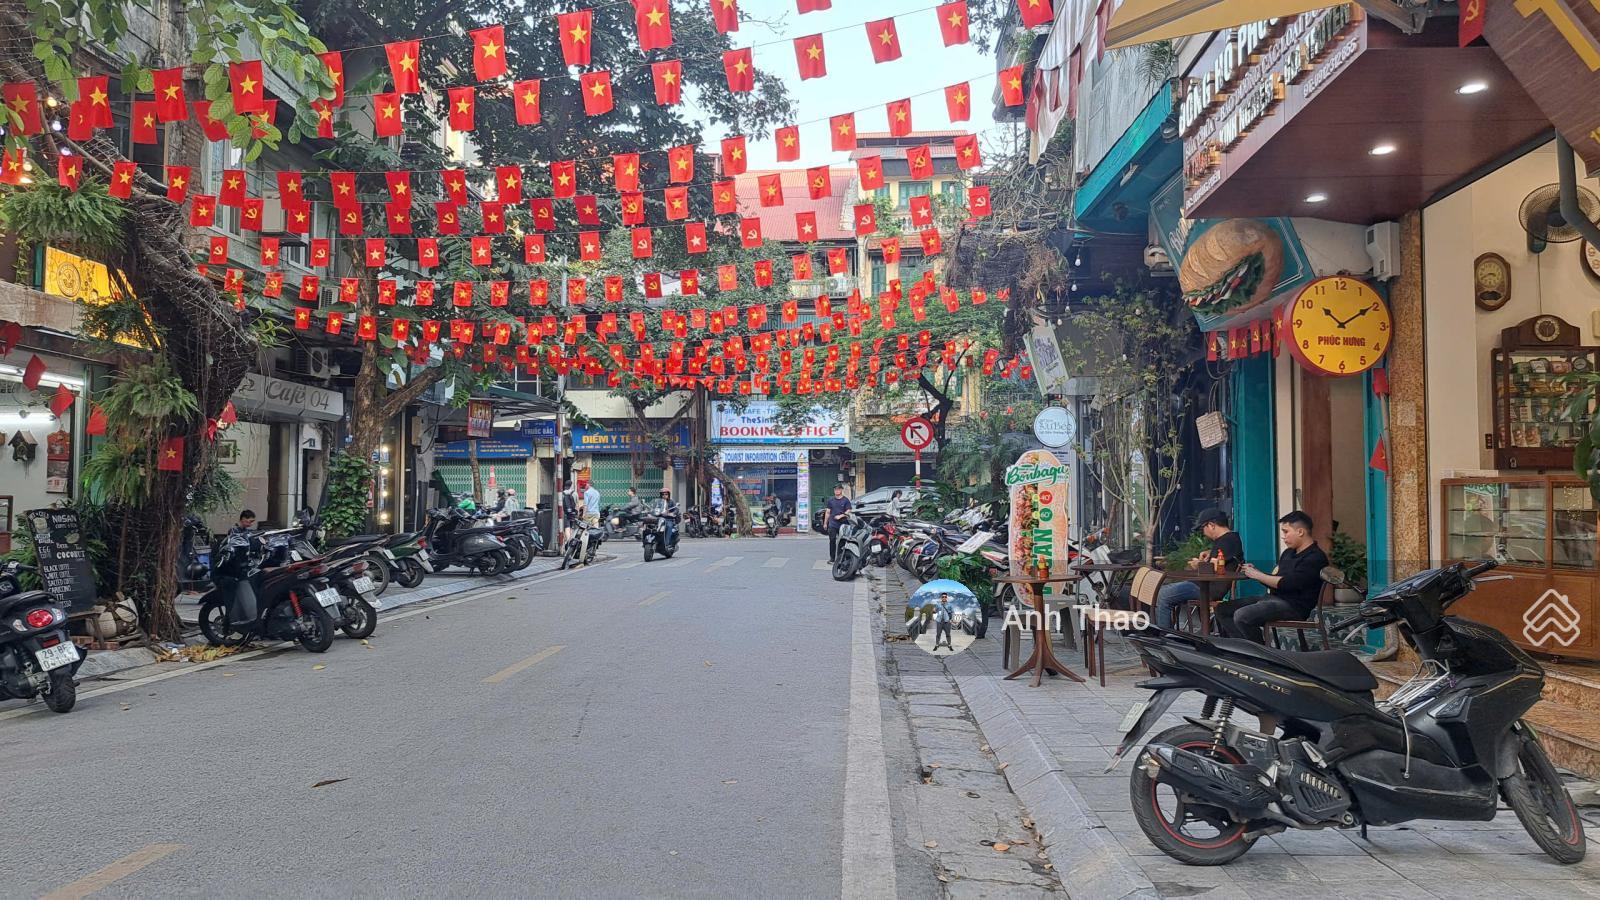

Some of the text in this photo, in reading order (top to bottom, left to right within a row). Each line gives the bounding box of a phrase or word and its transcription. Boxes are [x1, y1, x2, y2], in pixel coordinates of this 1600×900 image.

[1335, 281, 1347, 290] 12
[1315, 286, 1325, 295] 11
[1358, 287, 1362, 296] 1
[1301, 300, 1313, 309] 10
[1372, 302, 1379, 312] 2
[1296, 320, 1303, 328] 9
[1380, 322, 1386, 331] 3
[1303, 340, 1309, 349] 8
[1318, 335, 1365, 347] PHÚC HƯNG
[1374, 343, 1380, 351] 4
[1319, 355, 1324, 364] 7
[1360, 356, 1366, 365] 5
[1339, 361, 1345, 370] 6
[311, 391, 329, 411] 04
[611, 435, 618, 444] Y
